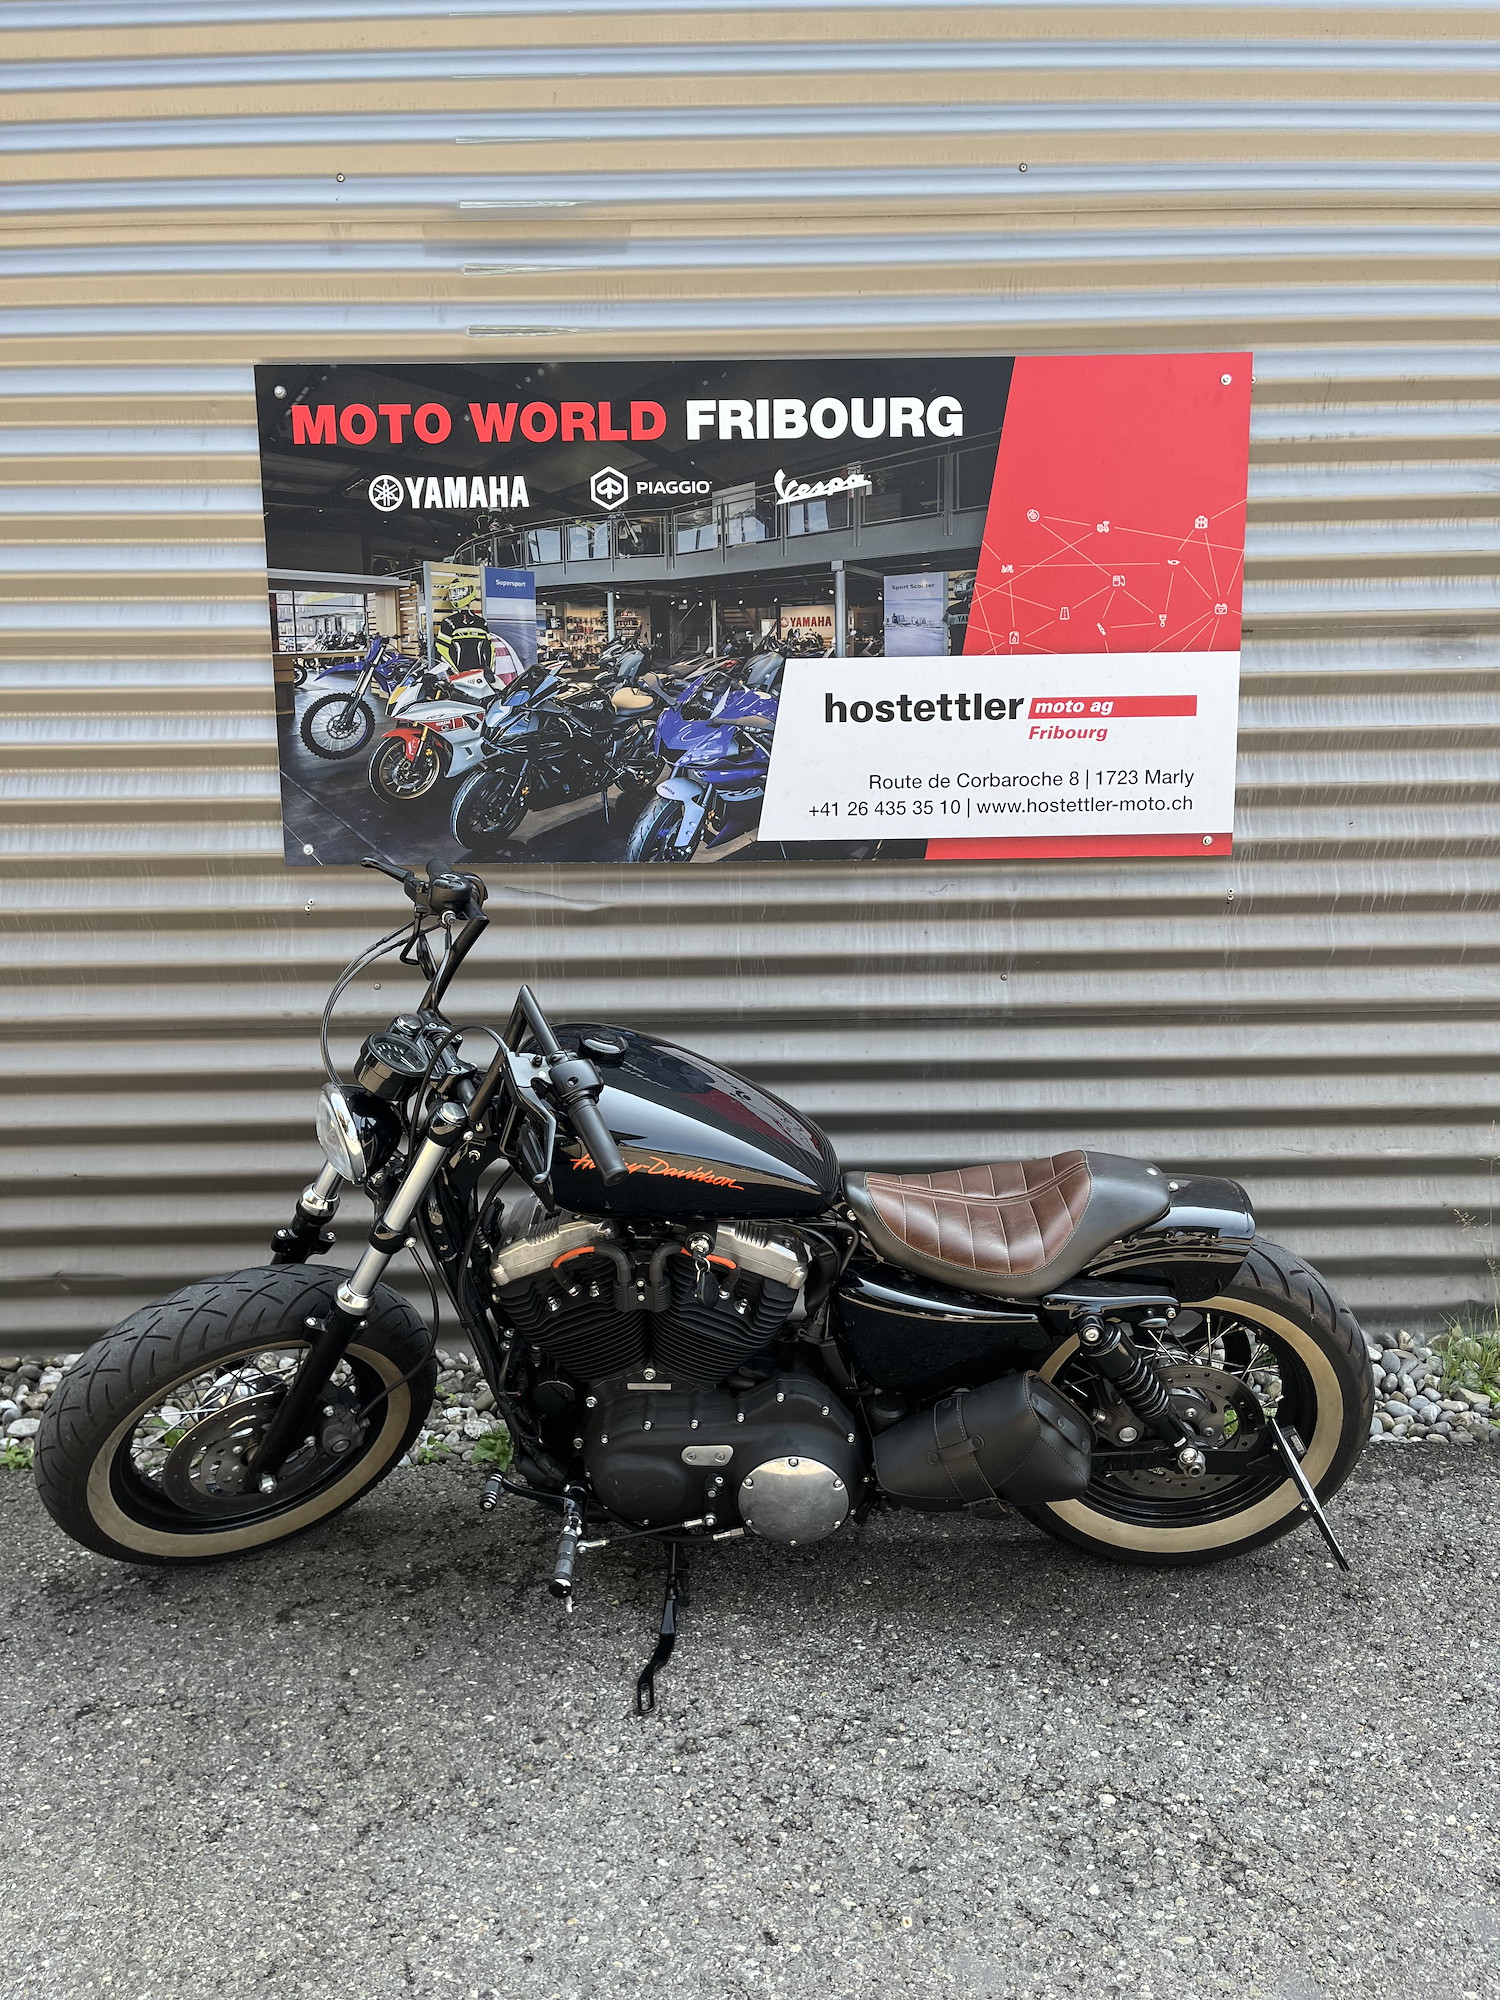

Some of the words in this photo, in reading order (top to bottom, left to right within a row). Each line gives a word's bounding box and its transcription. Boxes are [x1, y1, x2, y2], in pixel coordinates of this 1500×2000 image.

[291, 403, 452, 445] MOTO
[468, 400, 667, 444] WORLD
[686, 395, 964, 441] FRIBOURG
[404, 475, 530, 511] YAMAHA
[636, 481, 710, 495] PIAGGIO
[774, 468, 873, 505] Vespa
[495, 579, 527, 588] Supersport
[790, 615, 832, 627] YAMAHA
[825, 692, 1025, 723] hostettler
[1034, 700, 1085, 714] moto
[1089, 701, 1115, 716] ag
[1028, 725, 1109, 742] Fribourg
[869, 774, 923, 790] Route
[928, 773, 951, 788] de
[956, 772, 1064, 788] Corbaroche
[1069, 771, 1080, 786] 8
[1095, 770, 1139, 786] 1723
[1144, 769, 1195, 788] Marly
[808, 801, 839, 817] +41
[847, 801, 869, 816] 26
[874, 800, 907, 816] 435
[912, 800, 934, 815] 35
[940, 799, 961, 815] 10
[976, 795, 1193, 815] www.hostettler-moto.ch
